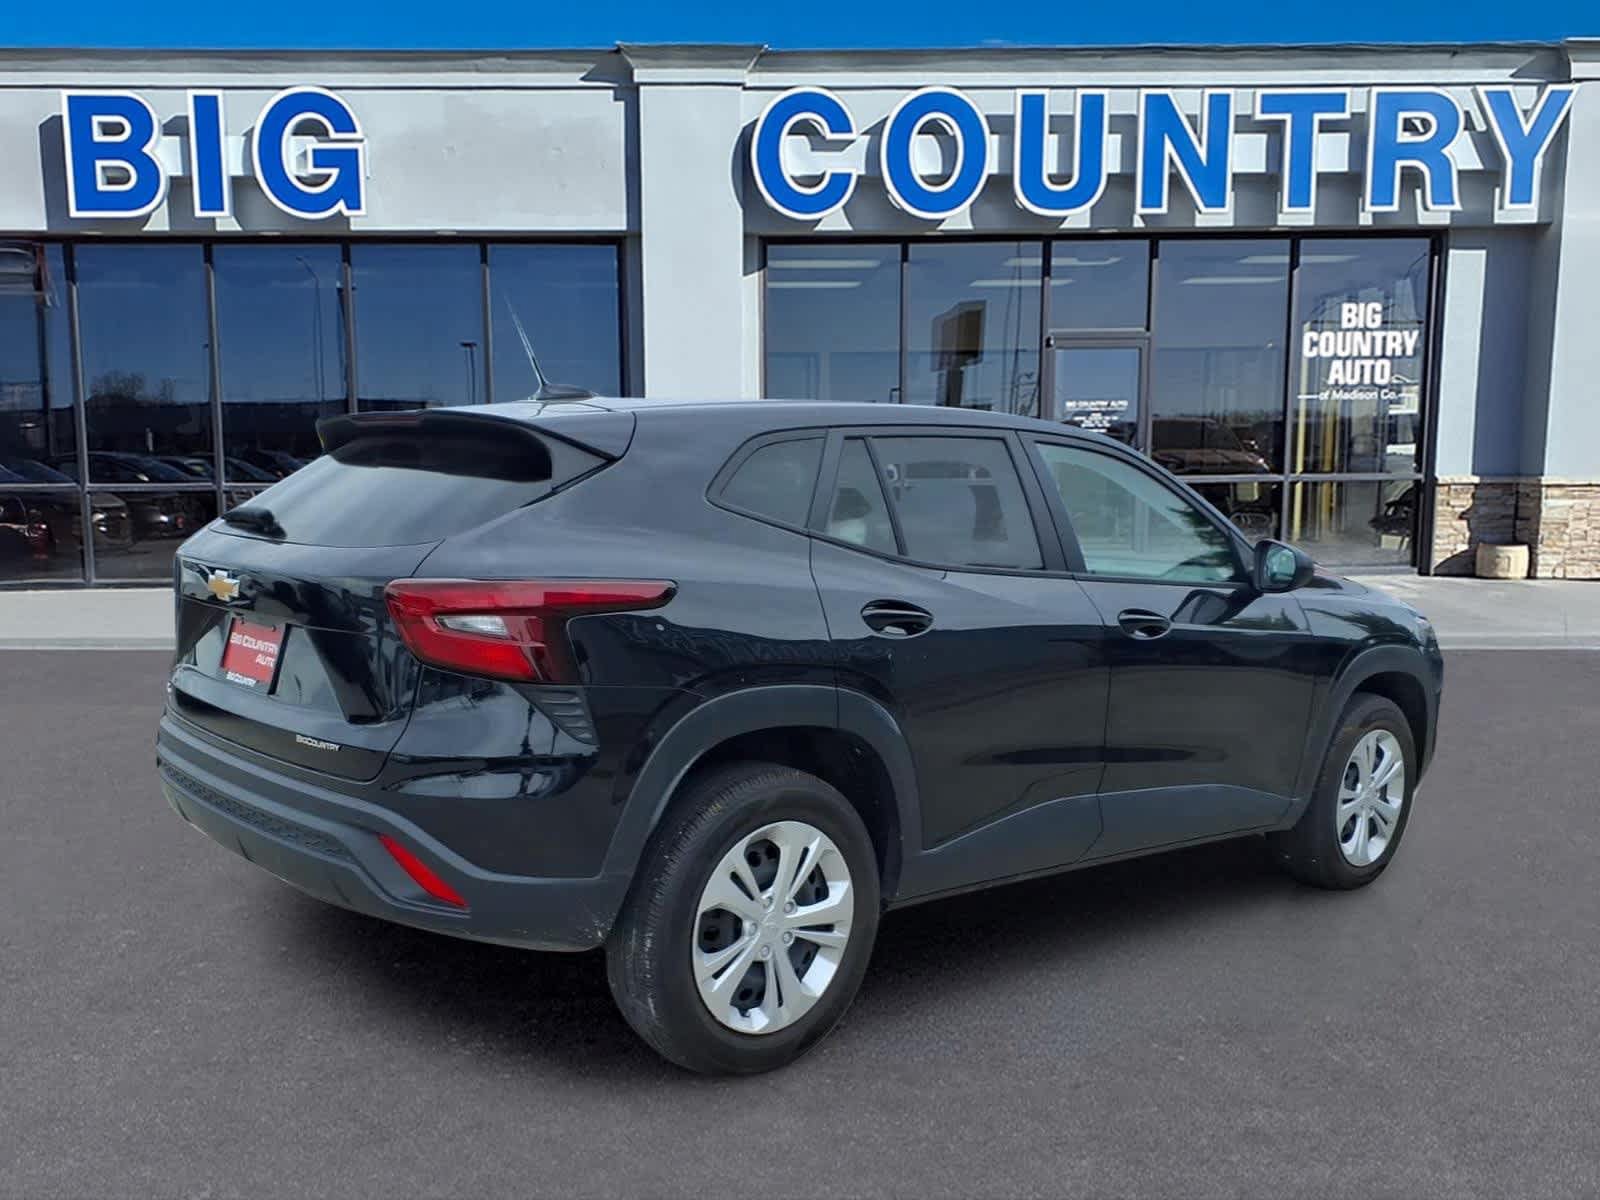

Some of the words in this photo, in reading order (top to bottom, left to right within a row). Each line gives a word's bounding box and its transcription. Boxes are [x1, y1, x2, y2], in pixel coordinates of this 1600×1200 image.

[61, 86, 367, 219] BIG
[750, 84, 1578, 221] COUNTRY
[1341, 302, 1382, 329] BIG
[1303, 330, 1419, 358] COUNTRY
[1327, 359, 1391, 385] AUTO
[1318, 389, 1330, 401] of
[1332, 389, 1379, 400] Madison
